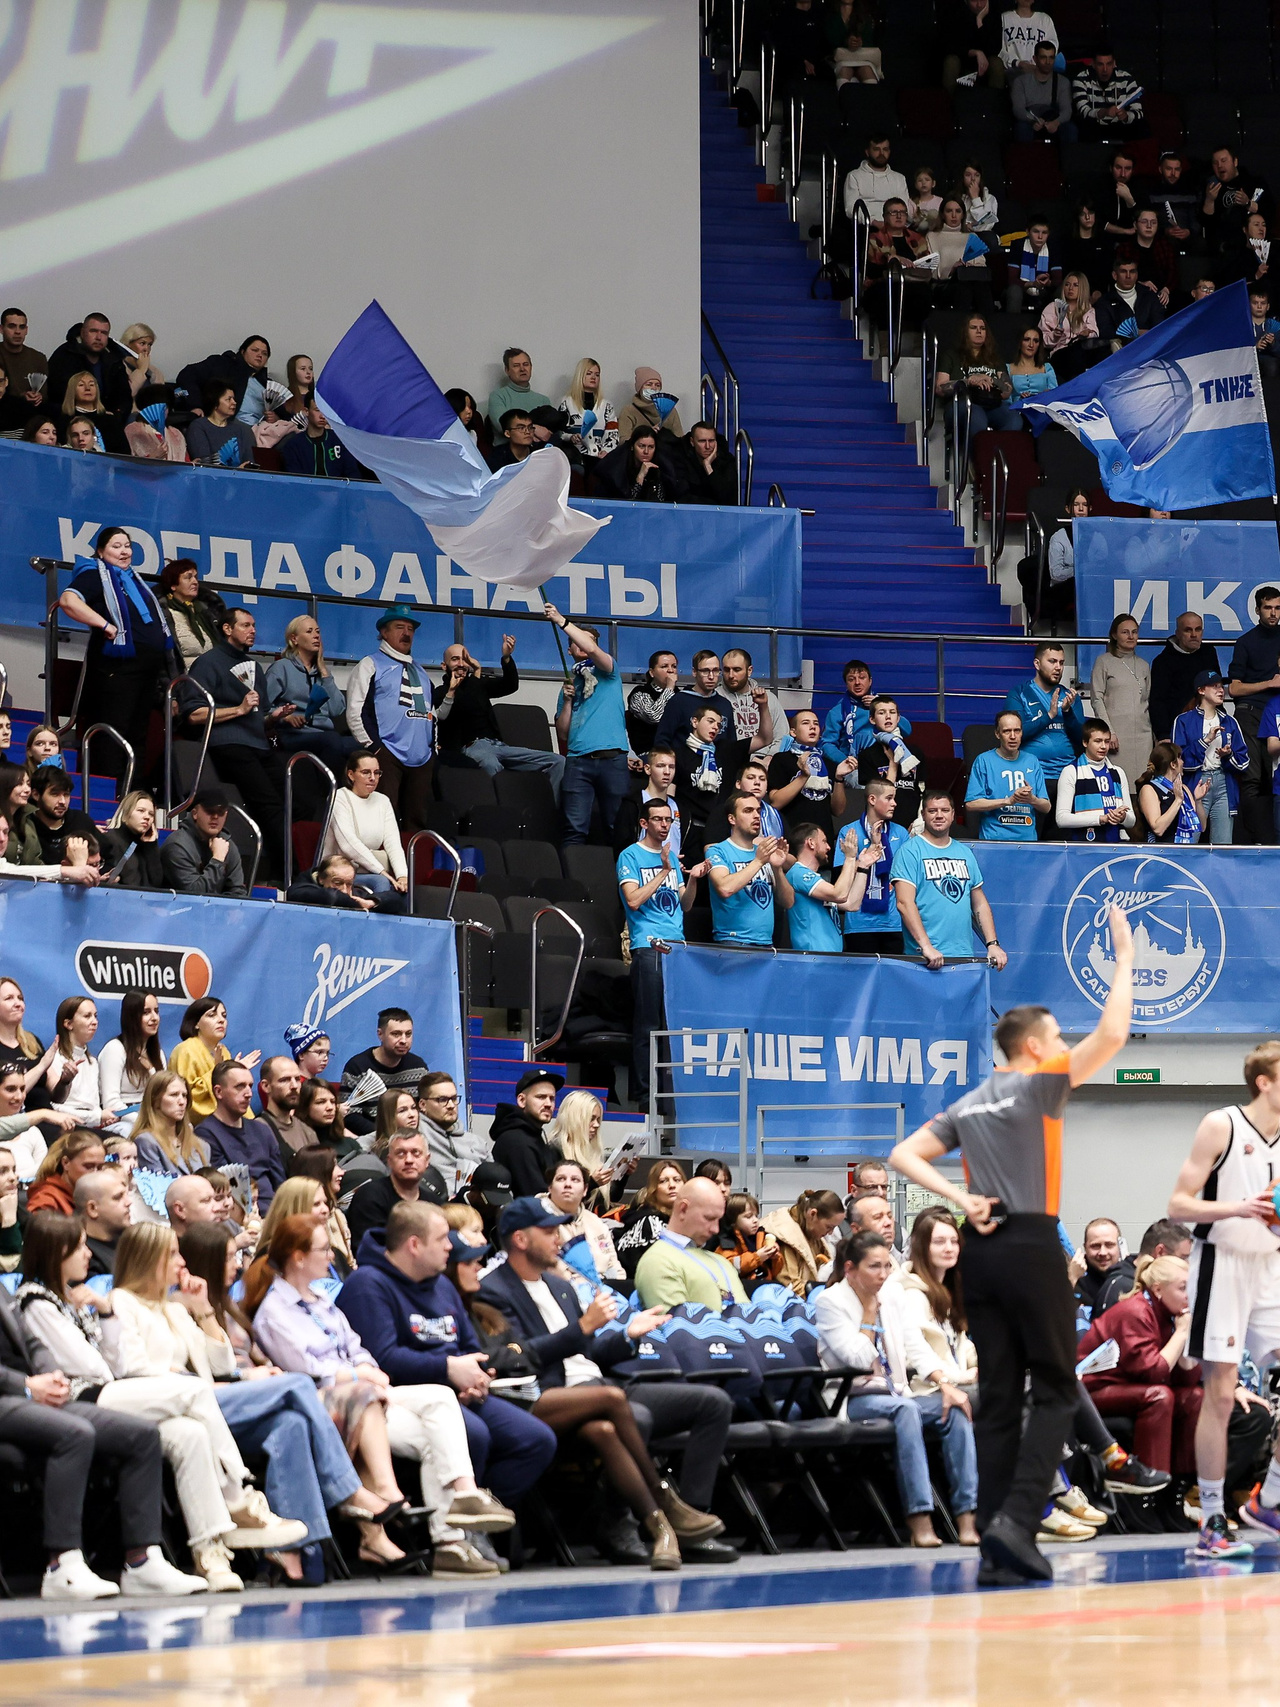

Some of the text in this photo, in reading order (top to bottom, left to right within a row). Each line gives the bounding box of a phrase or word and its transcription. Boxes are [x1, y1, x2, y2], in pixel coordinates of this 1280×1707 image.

[1004, 27, 1046, 42] YALE
[1113, 579, 1169, 631] И
[1001, 816, 1025, 824] Winline
[86, 953, 177, 991] Winline
[303, 943, 410, 1028] Зенит
[1080, 962, 1214, 1016] САН-ПЕТЕРБУРГ
[682, 1027, 968, 1086] НАШЕ ИМЯ
[1123, 1072, 1153, 1081] ВЫХОД
